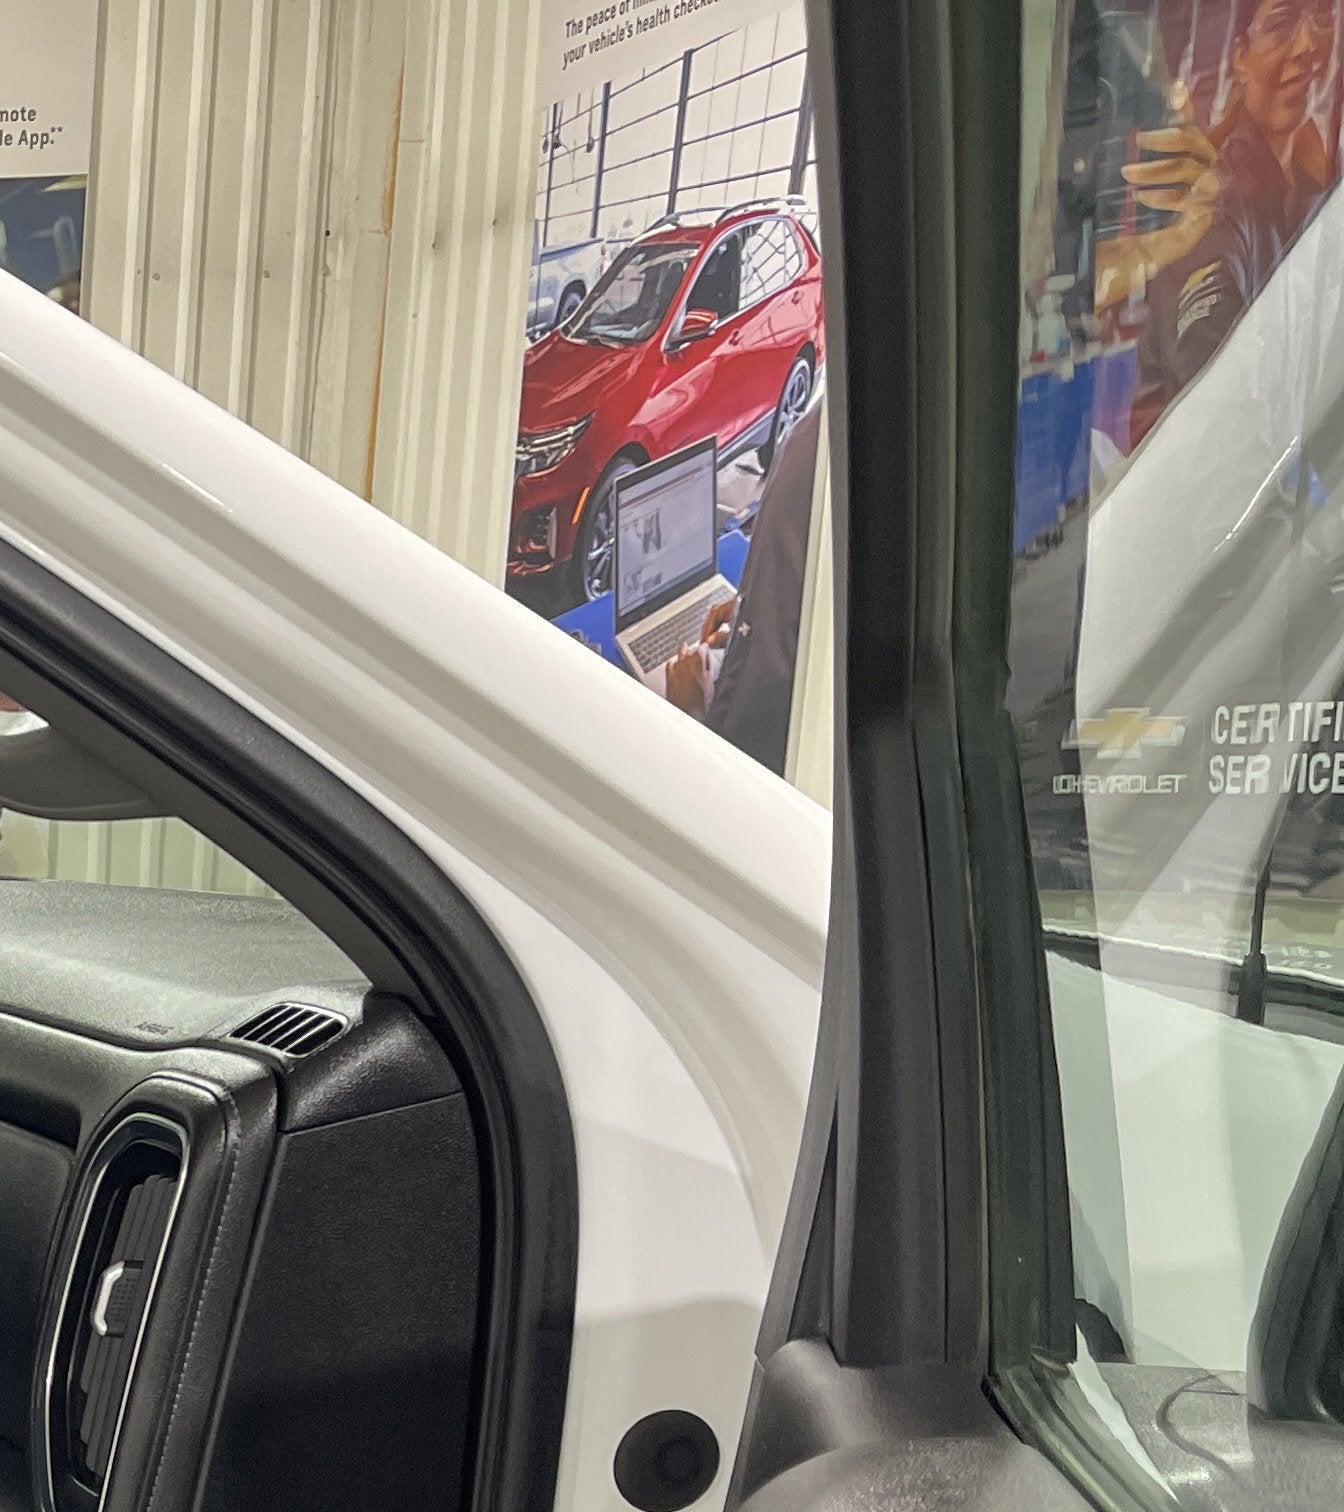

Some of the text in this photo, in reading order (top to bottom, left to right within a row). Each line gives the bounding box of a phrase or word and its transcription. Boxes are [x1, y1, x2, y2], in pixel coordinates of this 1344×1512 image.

[562, 43, 587, 71] your
[588, 20, 634, 55] vehicle's
[636, 6, 670, 36] health
[565, 17, 583, 39] The
[585, 7, 617, 36] peace
